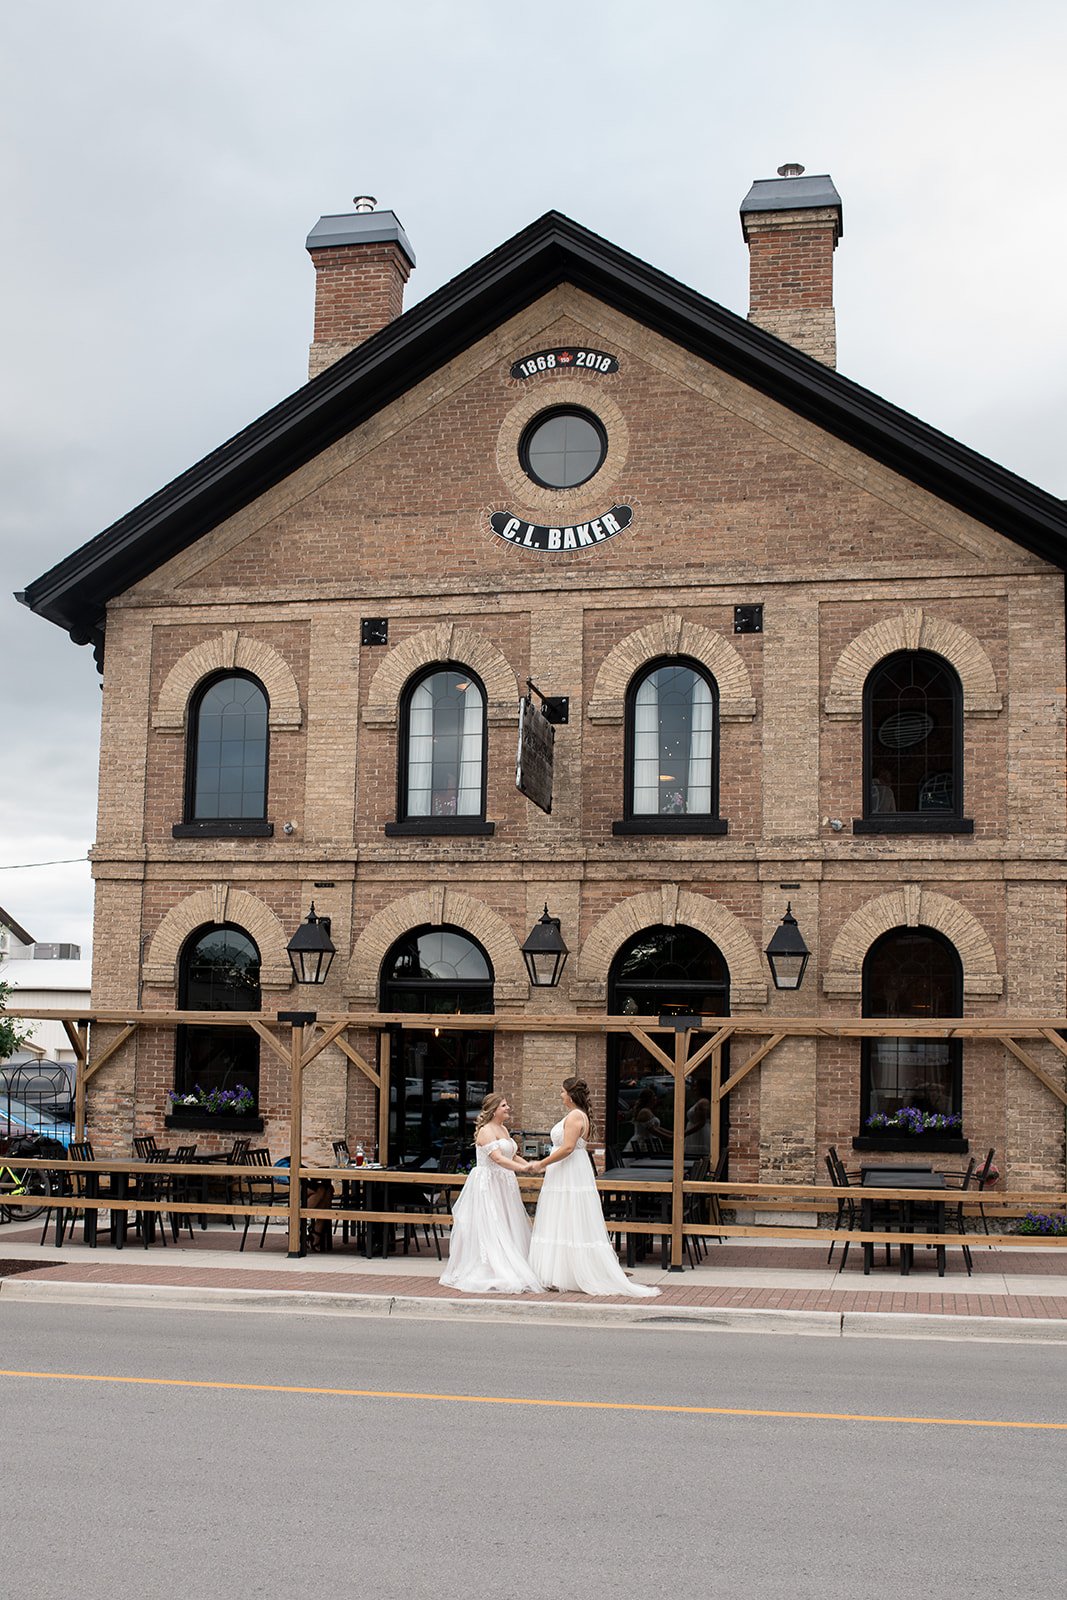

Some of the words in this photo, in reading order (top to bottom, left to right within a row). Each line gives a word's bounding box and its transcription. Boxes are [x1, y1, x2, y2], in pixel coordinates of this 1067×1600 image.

[520, 354, 556, 376] 1868
[576, 352, 611, 372] 2018
[503, 518, 539, 547] C.L.
[548, 513, 621, 550] BAKER
